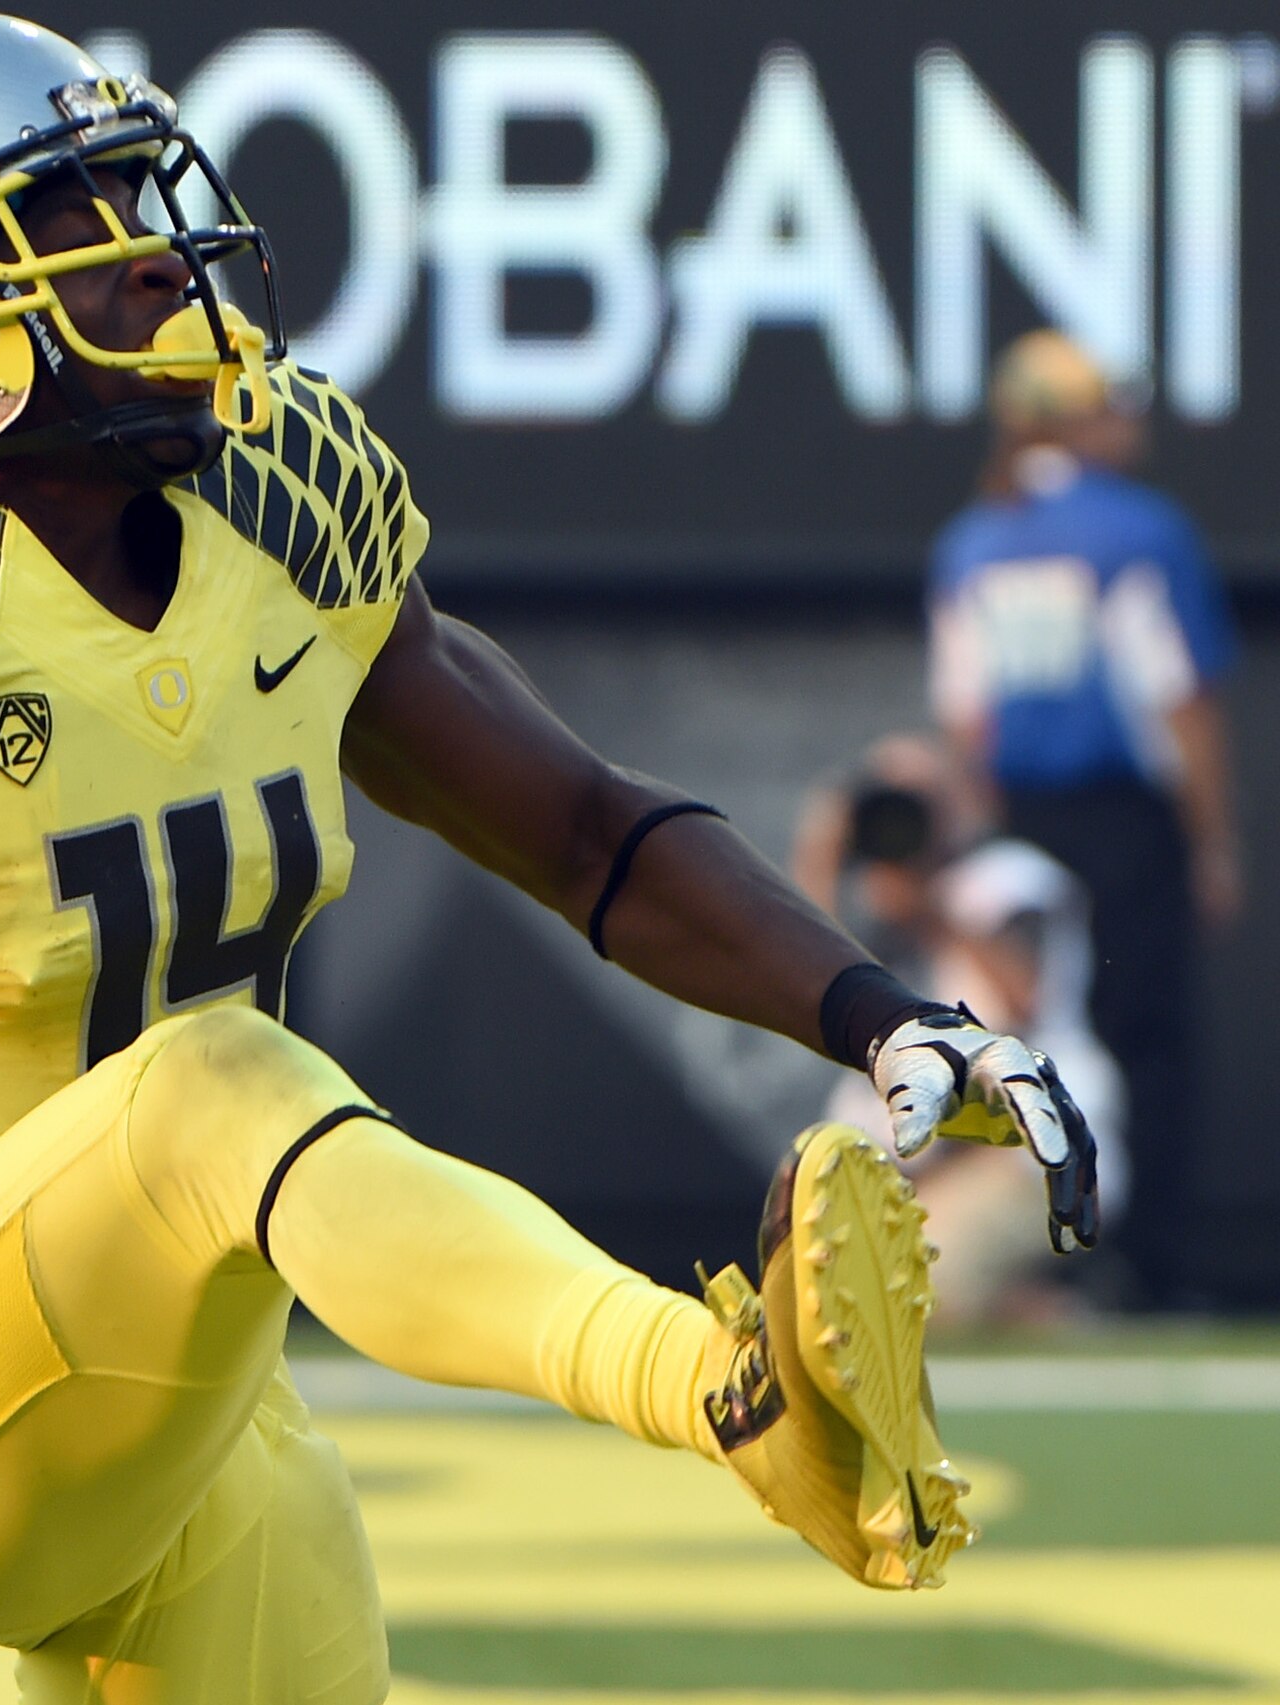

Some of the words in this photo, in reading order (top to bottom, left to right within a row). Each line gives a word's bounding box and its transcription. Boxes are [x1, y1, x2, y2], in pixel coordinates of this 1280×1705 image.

[149, 669, 187, 710] O
[0, 732, 37, 768] 12
[43, 766, 323, 1080] 14
